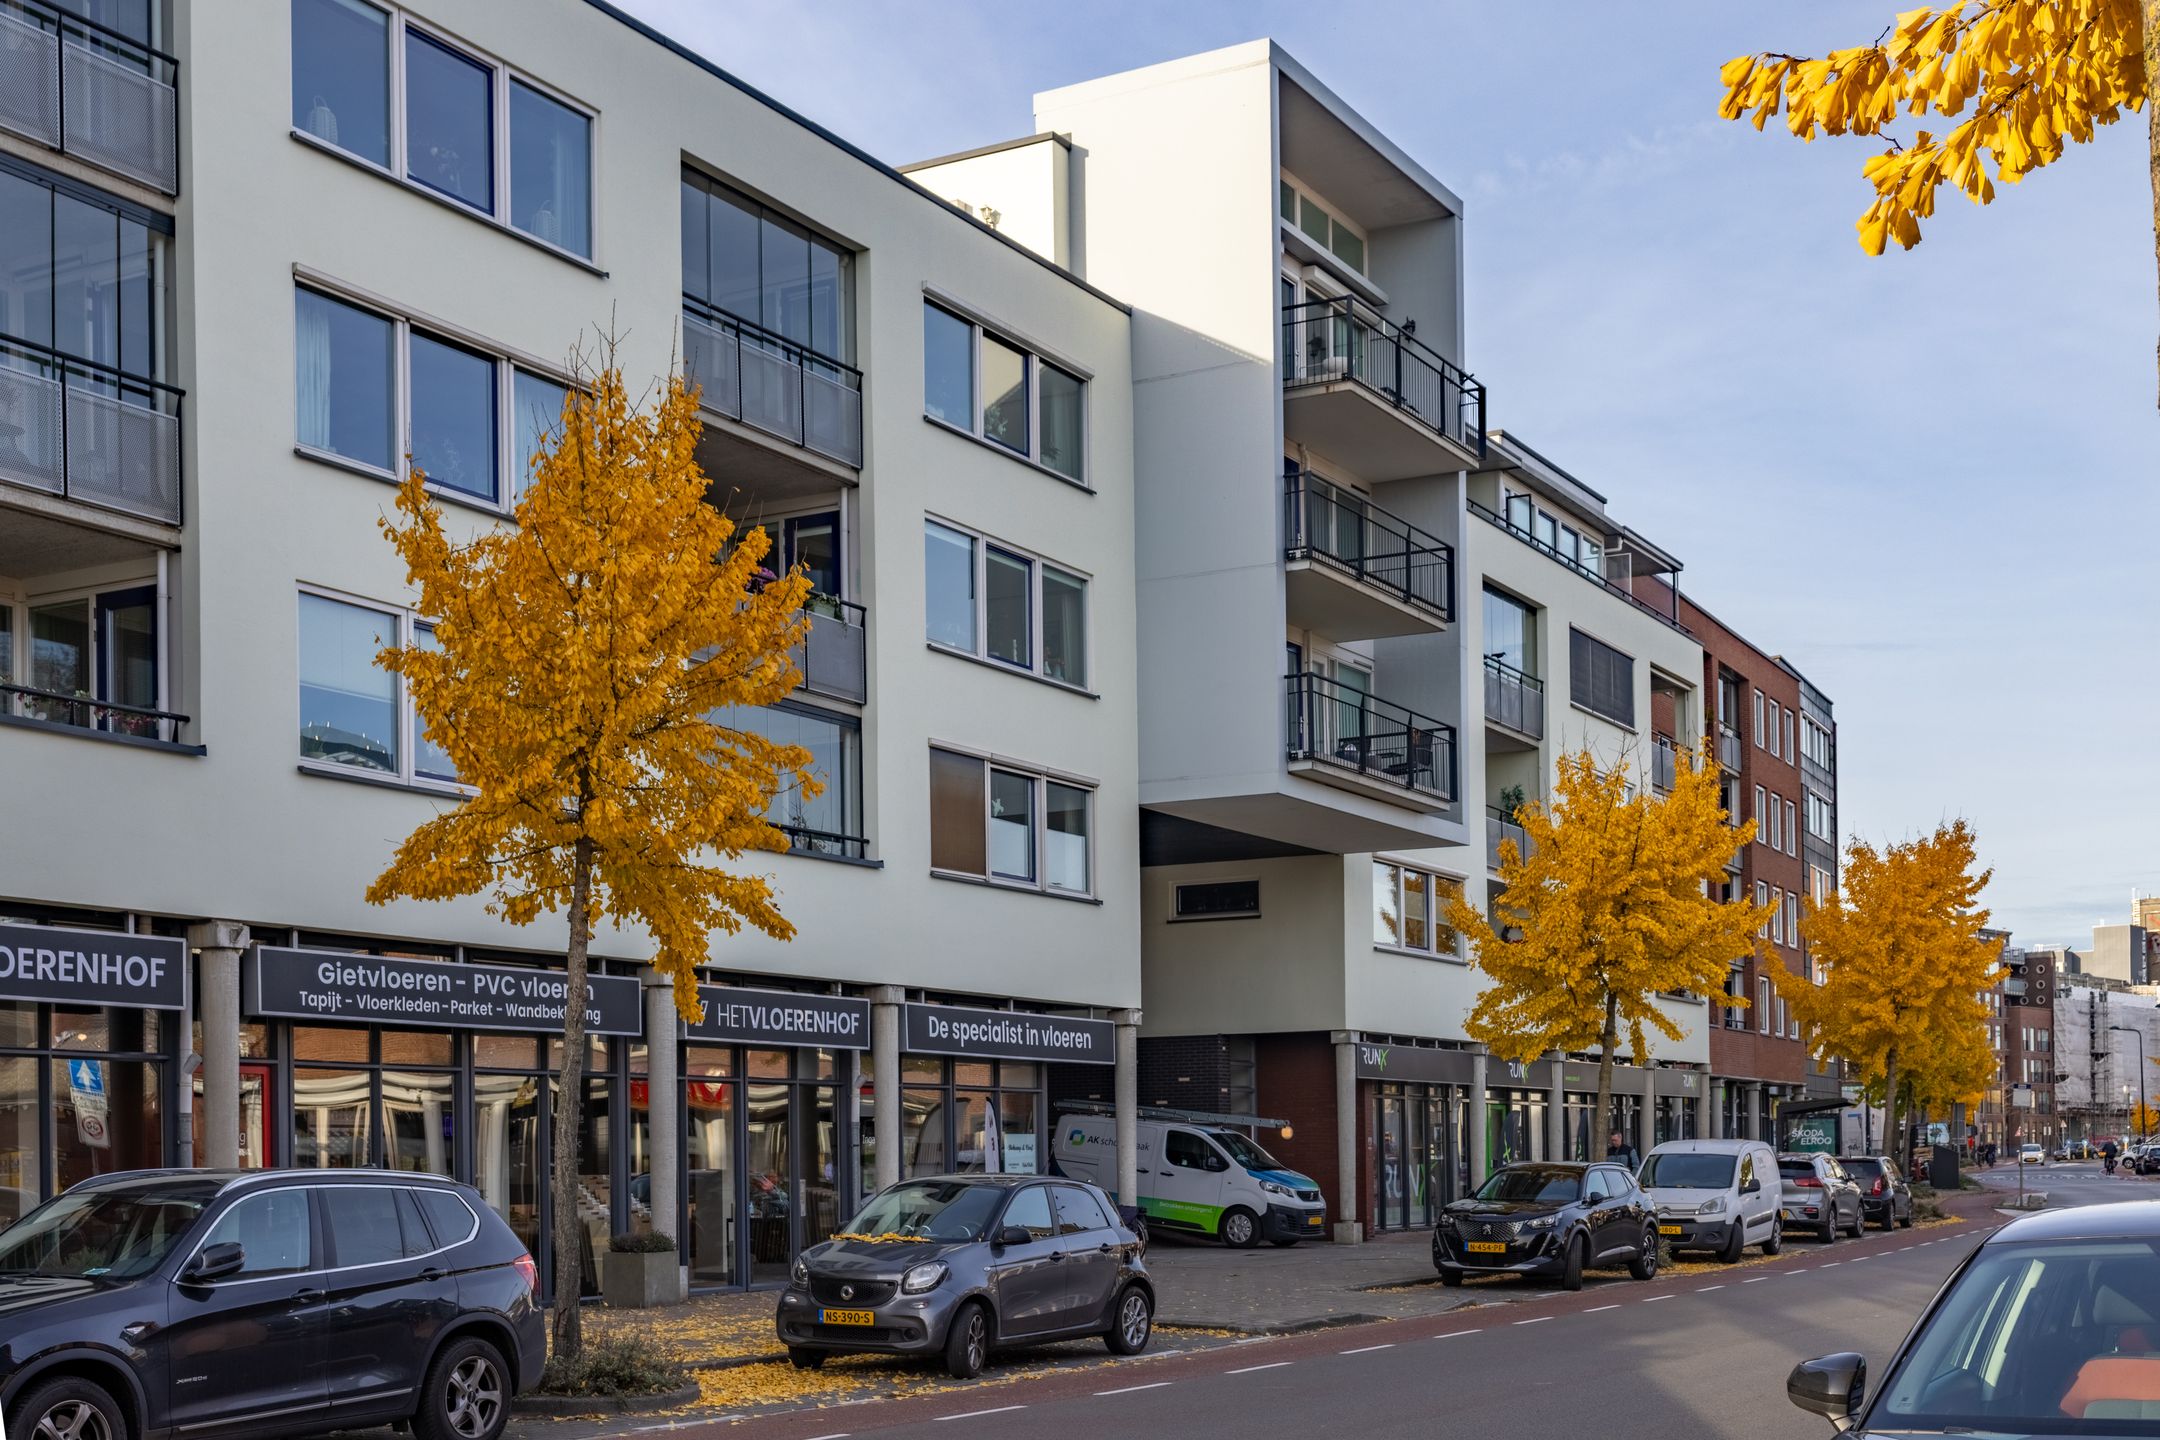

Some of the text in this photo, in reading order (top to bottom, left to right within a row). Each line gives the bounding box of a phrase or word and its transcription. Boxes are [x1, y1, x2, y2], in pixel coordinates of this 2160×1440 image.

[0, 946, 166, 988] OERENHOF
[318, 961, 451, 992] Gietvloeren
[474, 973, 516, 996] PVC
[520, 976, 594, 1001] vloern
[299, 991, 342, 1012] Tapijt
[356, 994, 440, 1014] Vloerkleden
[450, 1000, 493, 1016] Parket
[505, 1003, 601, 1026] Wandbeklng
[718, 1003, 860, 1035] HETVLOERENHOF
[928, 1015, 1092, 1049] De specialist in vloeren
[1361, 1046, 1390, 1072] RUNX
[1087, 1135, 1150, 1152] AK schoaak
[825, 1311, 871, 1323] NS-390-S
